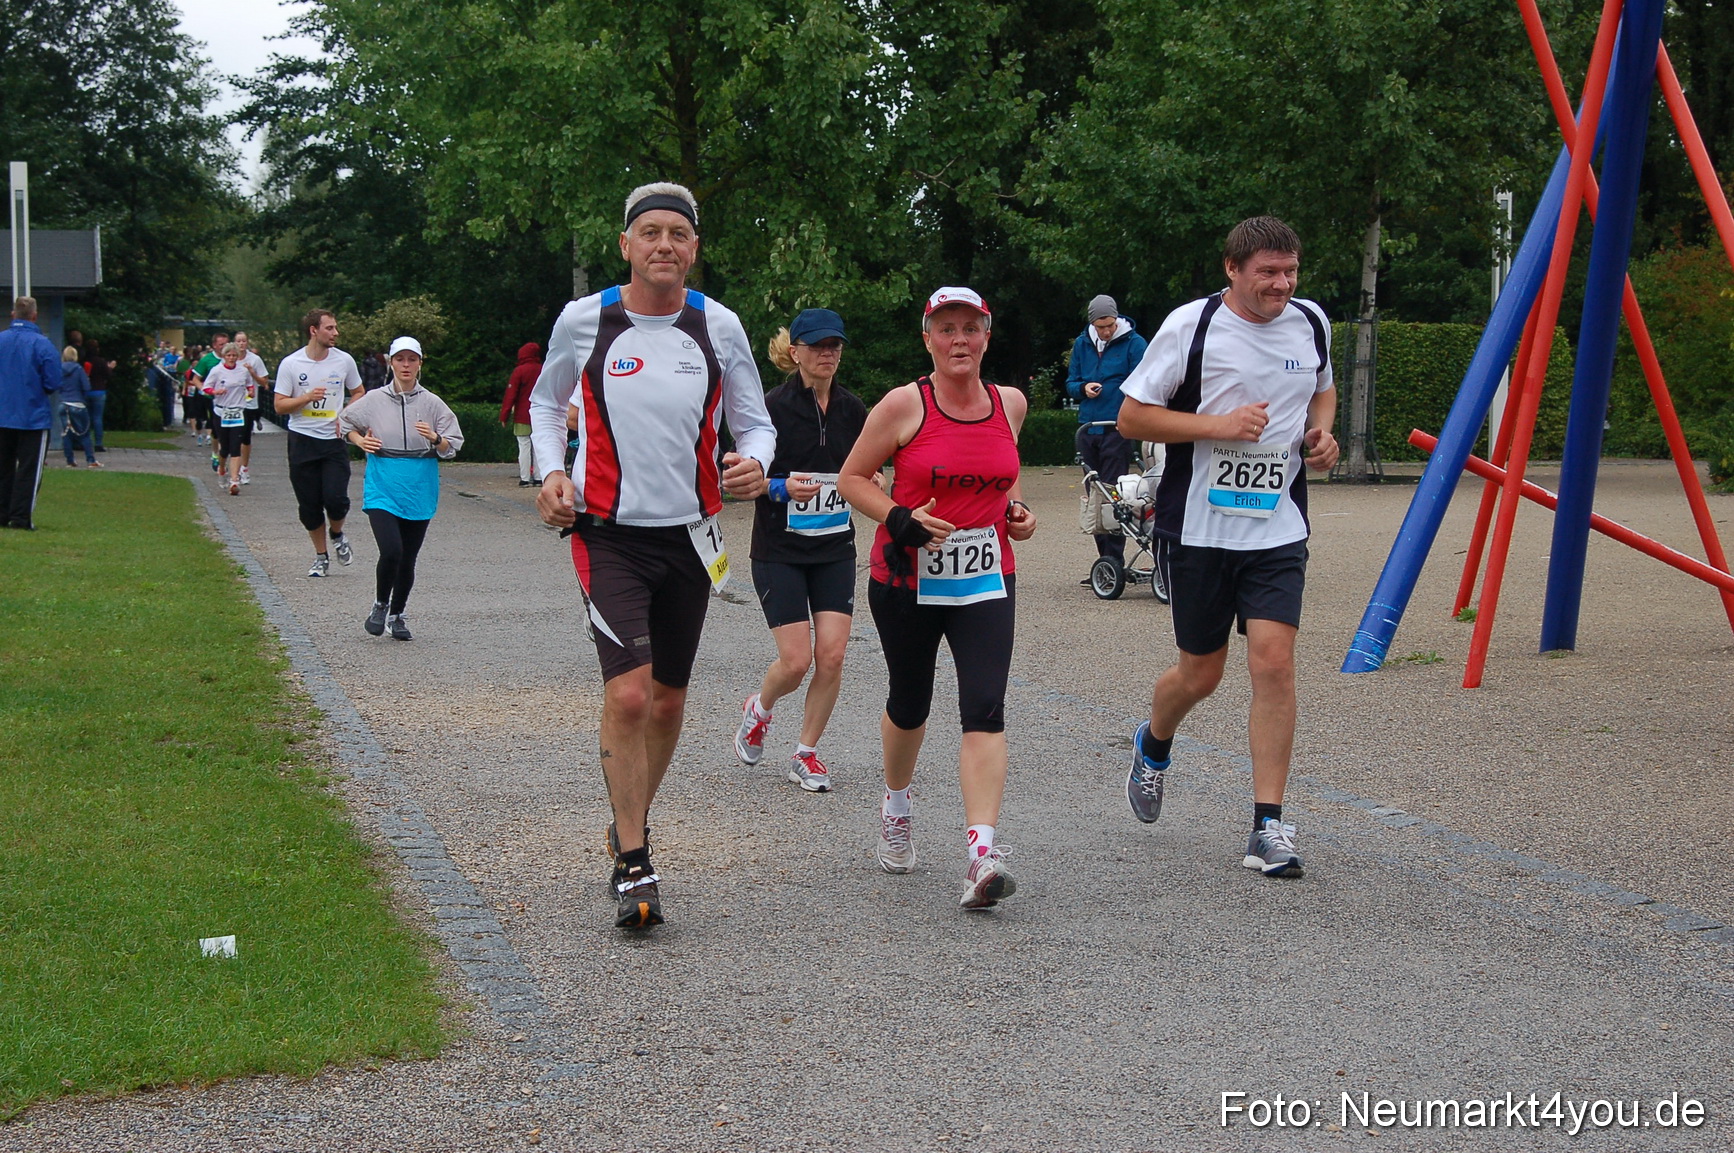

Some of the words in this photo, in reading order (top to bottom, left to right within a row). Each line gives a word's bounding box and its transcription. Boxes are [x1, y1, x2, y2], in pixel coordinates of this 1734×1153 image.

[612, 359, 635, 370] tkn
[1212, 447, 1241, 459] PARTL
[1241, 451, 1279, 459] Neumarkt
[1216, 459, 1284, 490] 2625
[1234, 495, 1261, 507] Erich
[951, 532, 987, 544] Neumarkt
[927, 542, 995, 576] 3126
